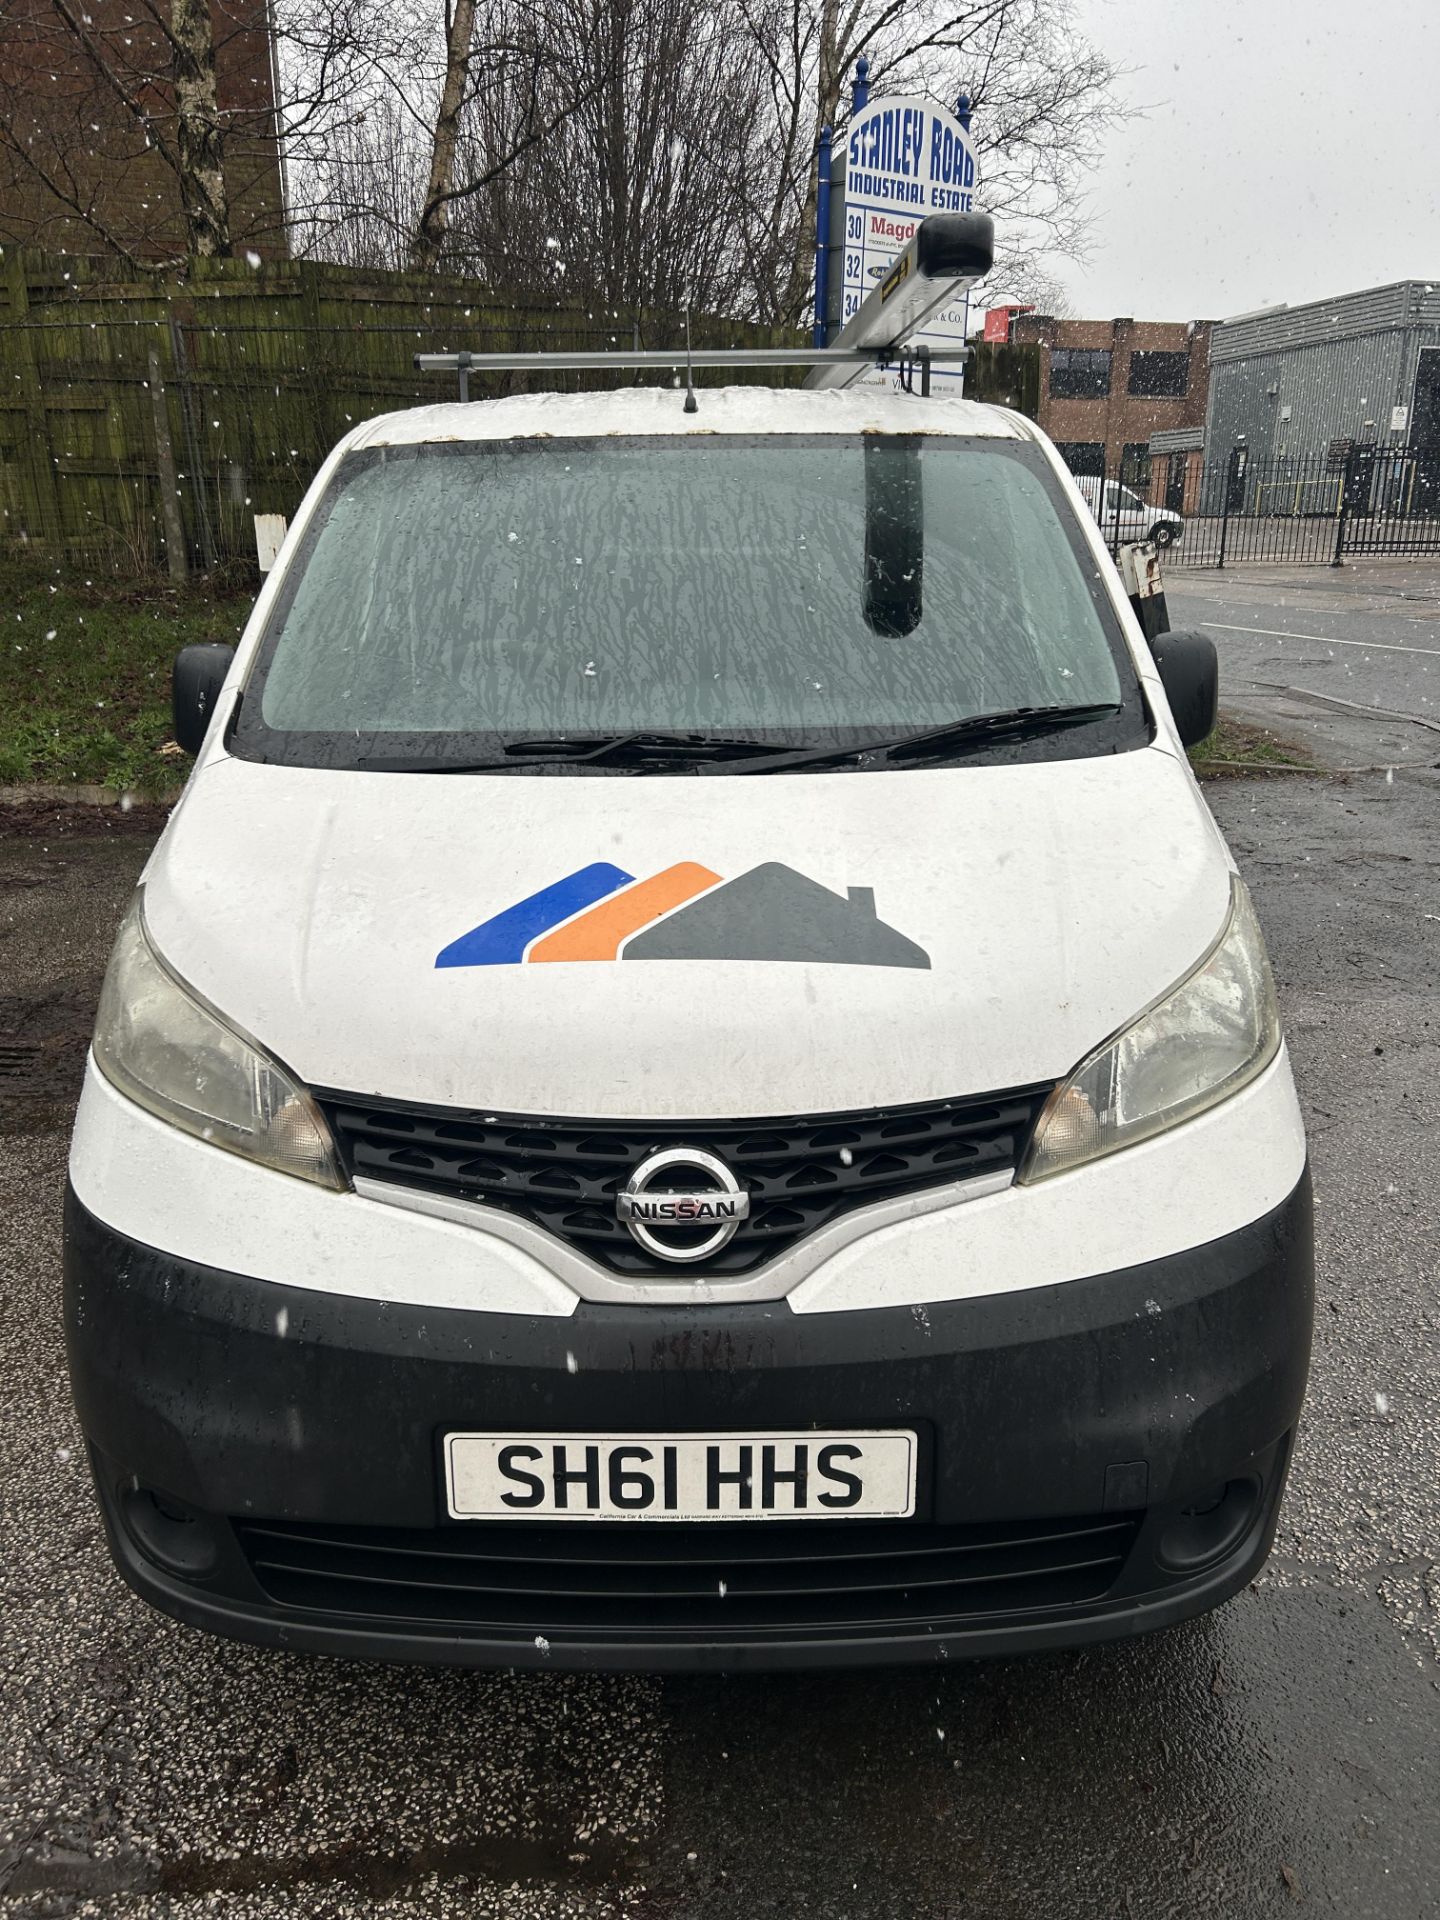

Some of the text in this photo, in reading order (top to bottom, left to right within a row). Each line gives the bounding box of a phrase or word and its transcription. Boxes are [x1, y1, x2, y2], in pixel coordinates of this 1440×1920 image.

[849, 108, 974, 188] STANLEY ROAD
[848, 171, 973, 212] INDUSTRIAL ESTATE
[848, 215, 862, 239] 30
[846, 254, 860, 278] 32
[845, 294, 858, 316] 34
[630, 1200, 735, 1219] NISSAN
[497, 1444, 864, 1510] SH61 HHS
